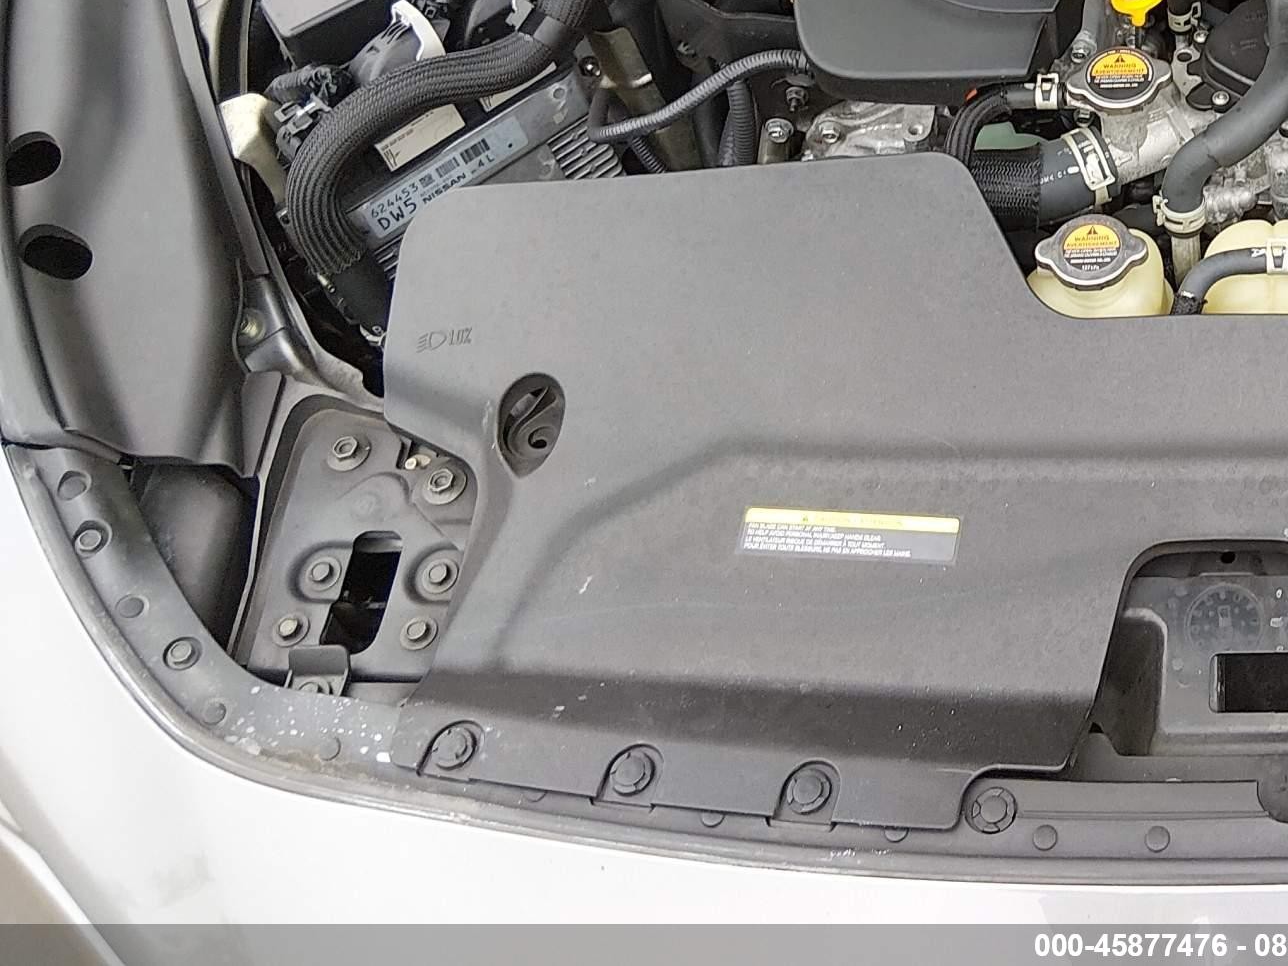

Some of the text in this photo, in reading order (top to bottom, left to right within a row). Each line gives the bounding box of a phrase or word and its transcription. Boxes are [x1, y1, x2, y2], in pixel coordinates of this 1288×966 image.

[370, 180, 419, 218] 624453
[422, 172, 467, 205] NISSAN
[377, 198, 418, 231] DW5
